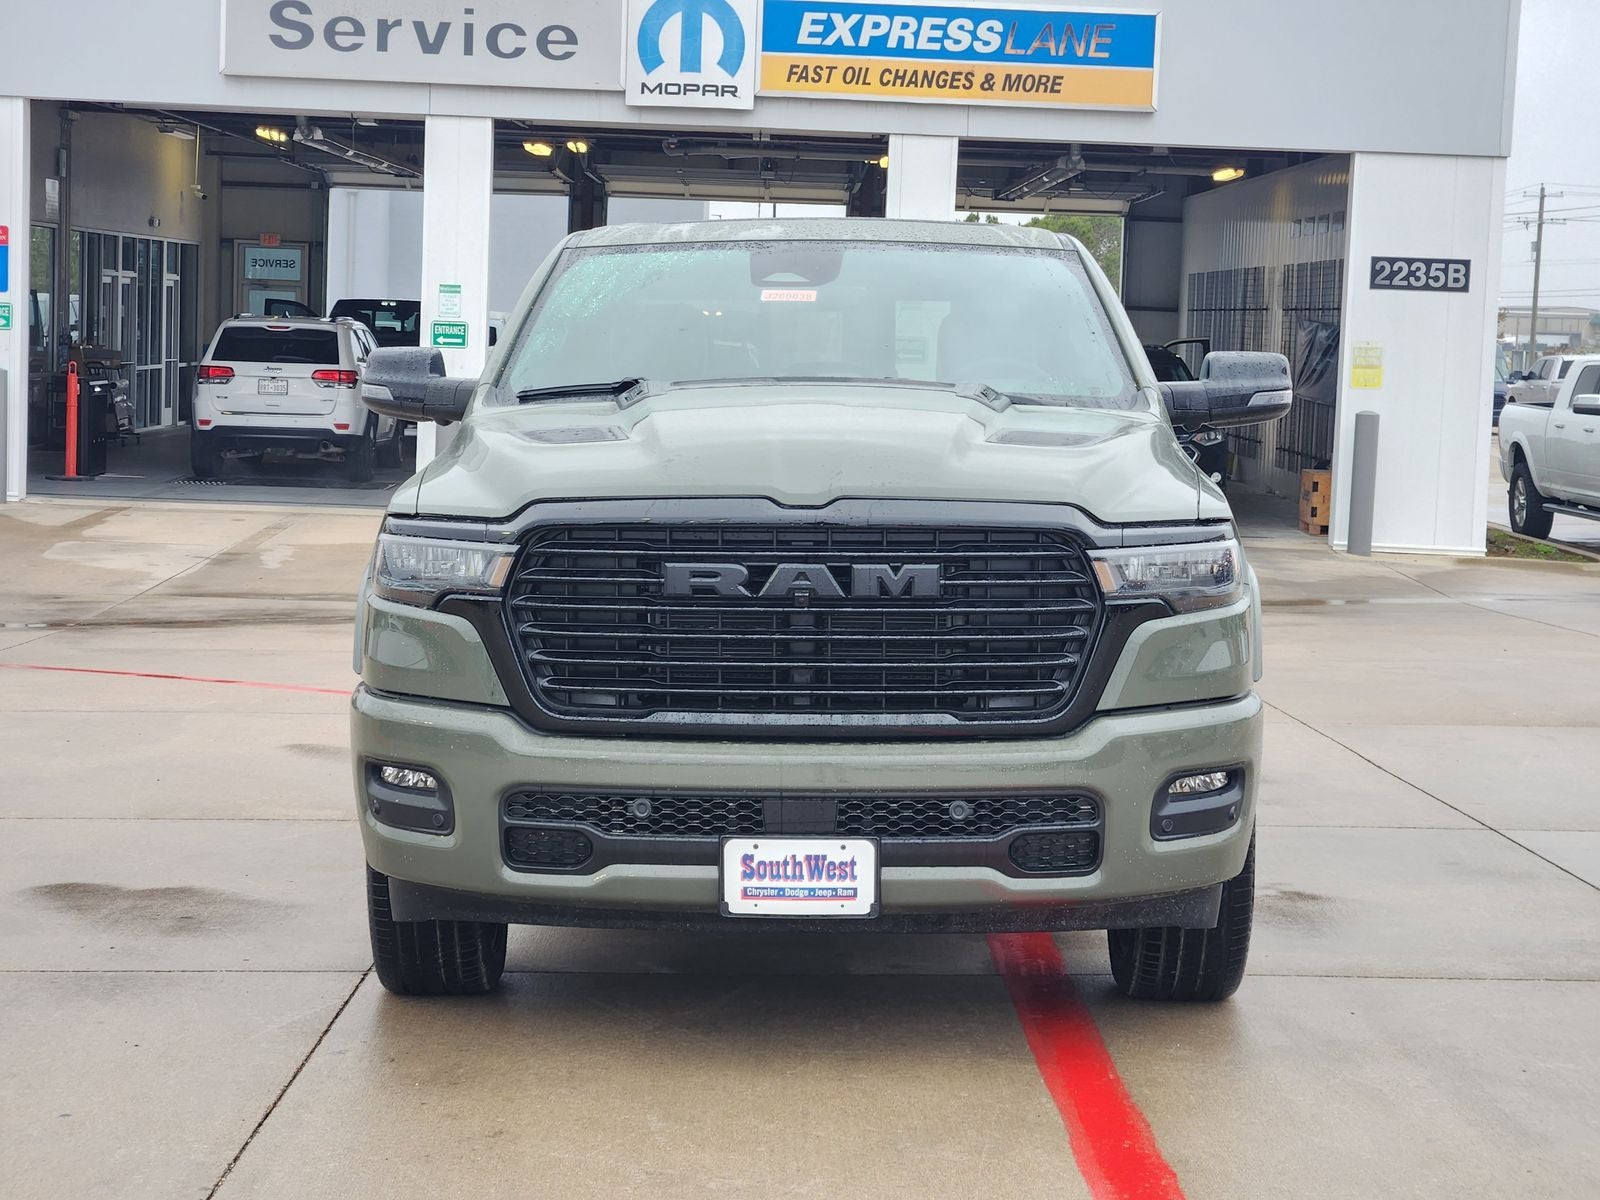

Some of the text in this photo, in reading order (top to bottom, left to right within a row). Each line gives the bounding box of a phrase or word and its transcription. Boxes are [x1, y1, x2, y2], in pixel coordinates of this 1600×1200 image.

[269, 0, 579, 61] Service
[640, 82, 738, 98] MOPAR
[786, 64, 1064, 94] FAST OIL CHANGES & MORE
[1374, 260, 1466, 288] 2235B
[434, 325, 465, 335] ENTRANCE
[664, 562, 940, 598] RAM
[740, 853, 858, 882] SouthWest
[747, 887, 854, 898] Chrysler Dodge Jeep Ram
